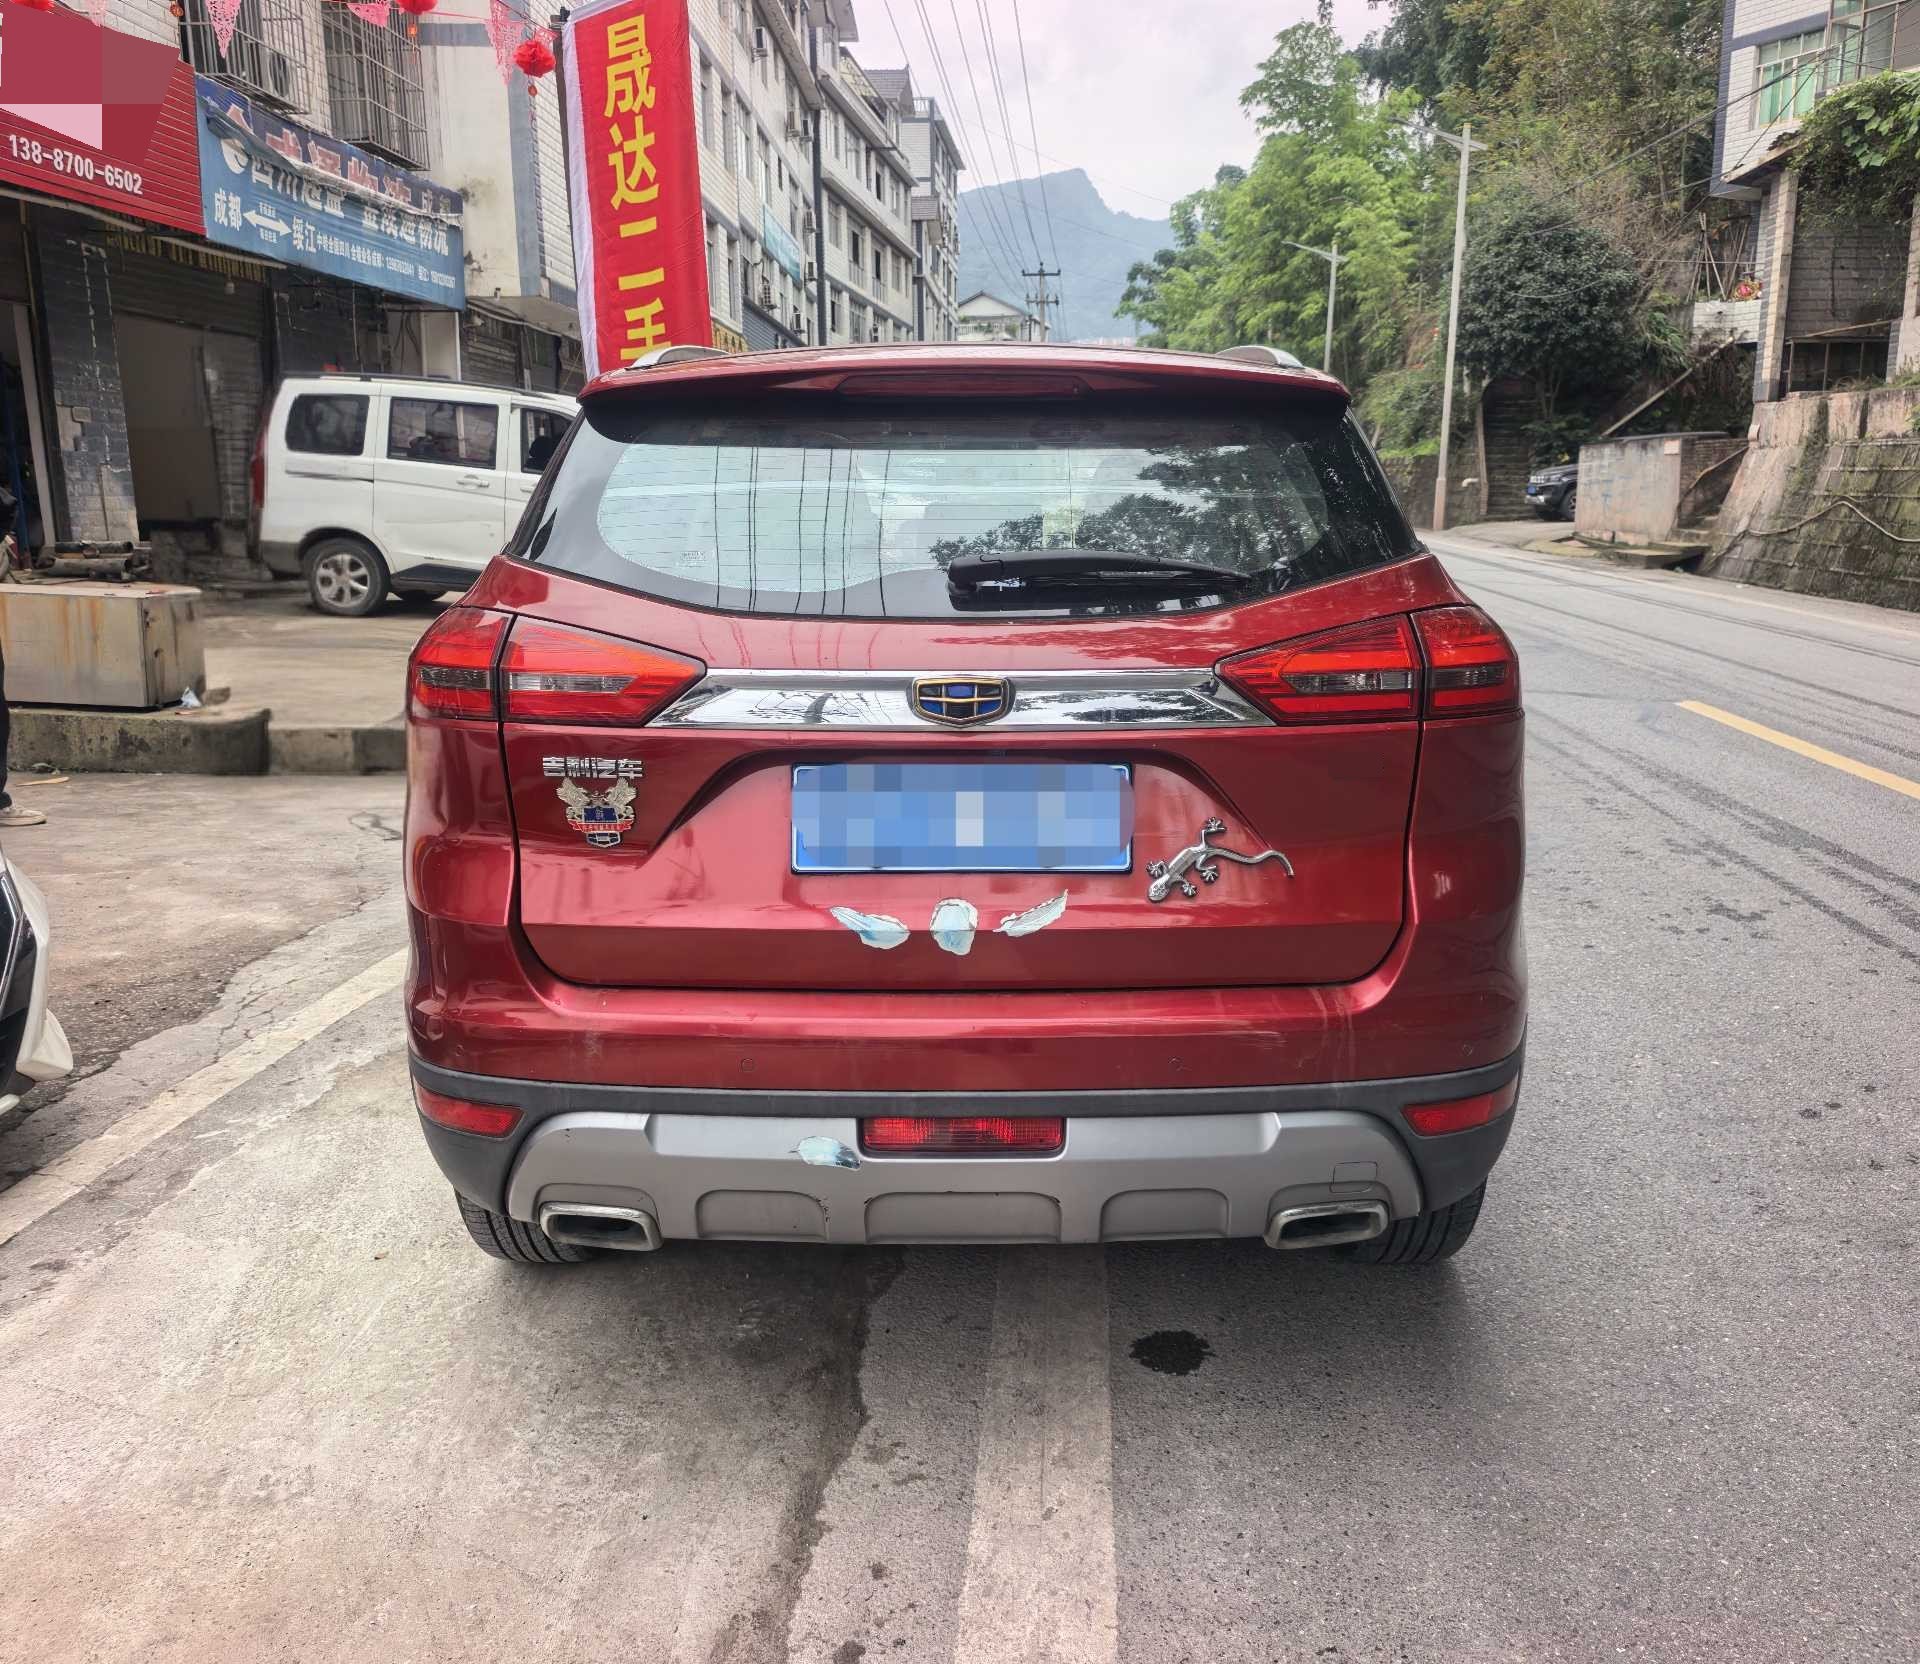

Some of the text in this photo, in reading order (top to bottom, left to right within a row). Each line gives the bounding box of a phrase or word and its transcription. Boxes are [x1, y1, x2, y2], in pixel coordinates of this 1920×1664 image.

[8, 133, 143, 195] 138-8700-6502
[214, 188, 243, 232] 成都
[291, 215, 317, 253] 绥江
[542, 756, 643, 779] 吉利汽车
